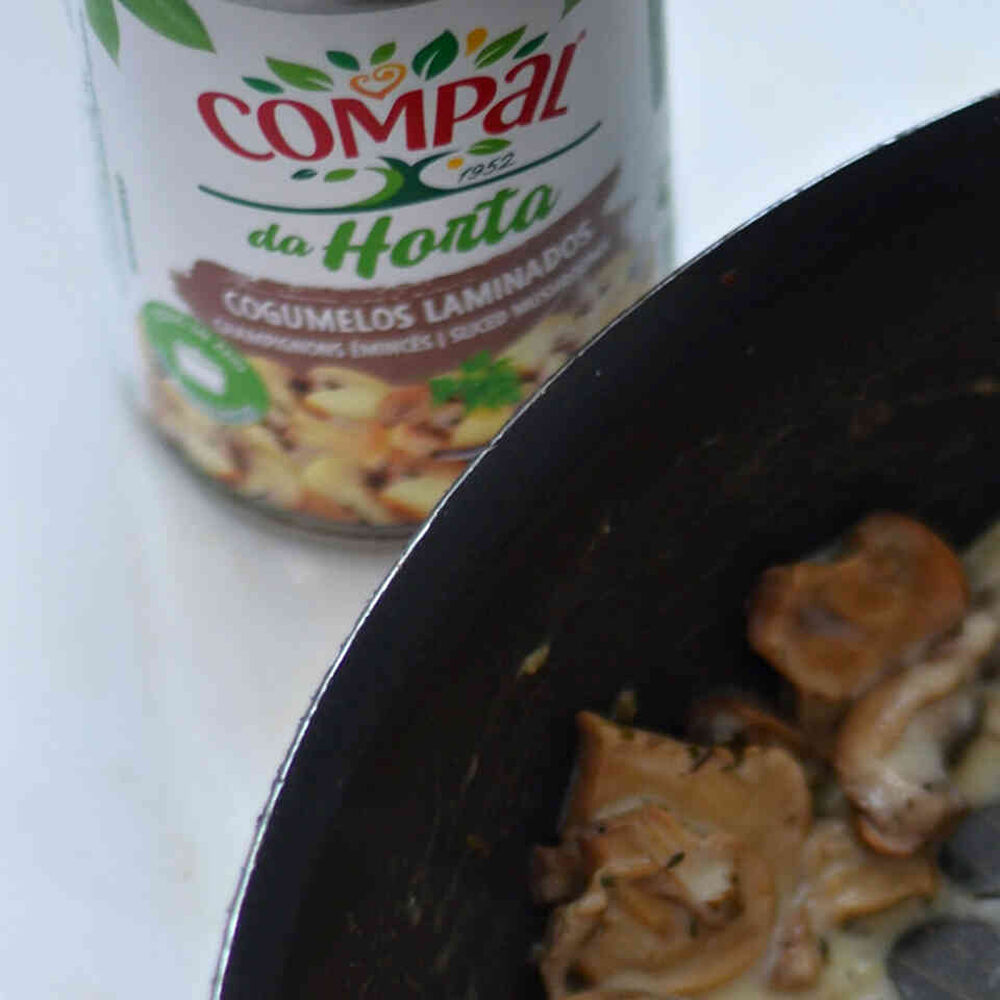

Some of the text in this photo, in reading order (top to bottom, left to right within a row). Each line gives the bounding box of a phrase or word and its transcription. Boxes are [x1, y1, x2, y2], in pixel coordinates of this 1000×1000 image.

[458, 152, 517, 184] 1952
[224, 291, 415, 333] COGUMELOS
[422, 218, 594, 324] LAMINADOS
[247, 223, 312, 257] da
[323, 184, 557, 280] Horta
